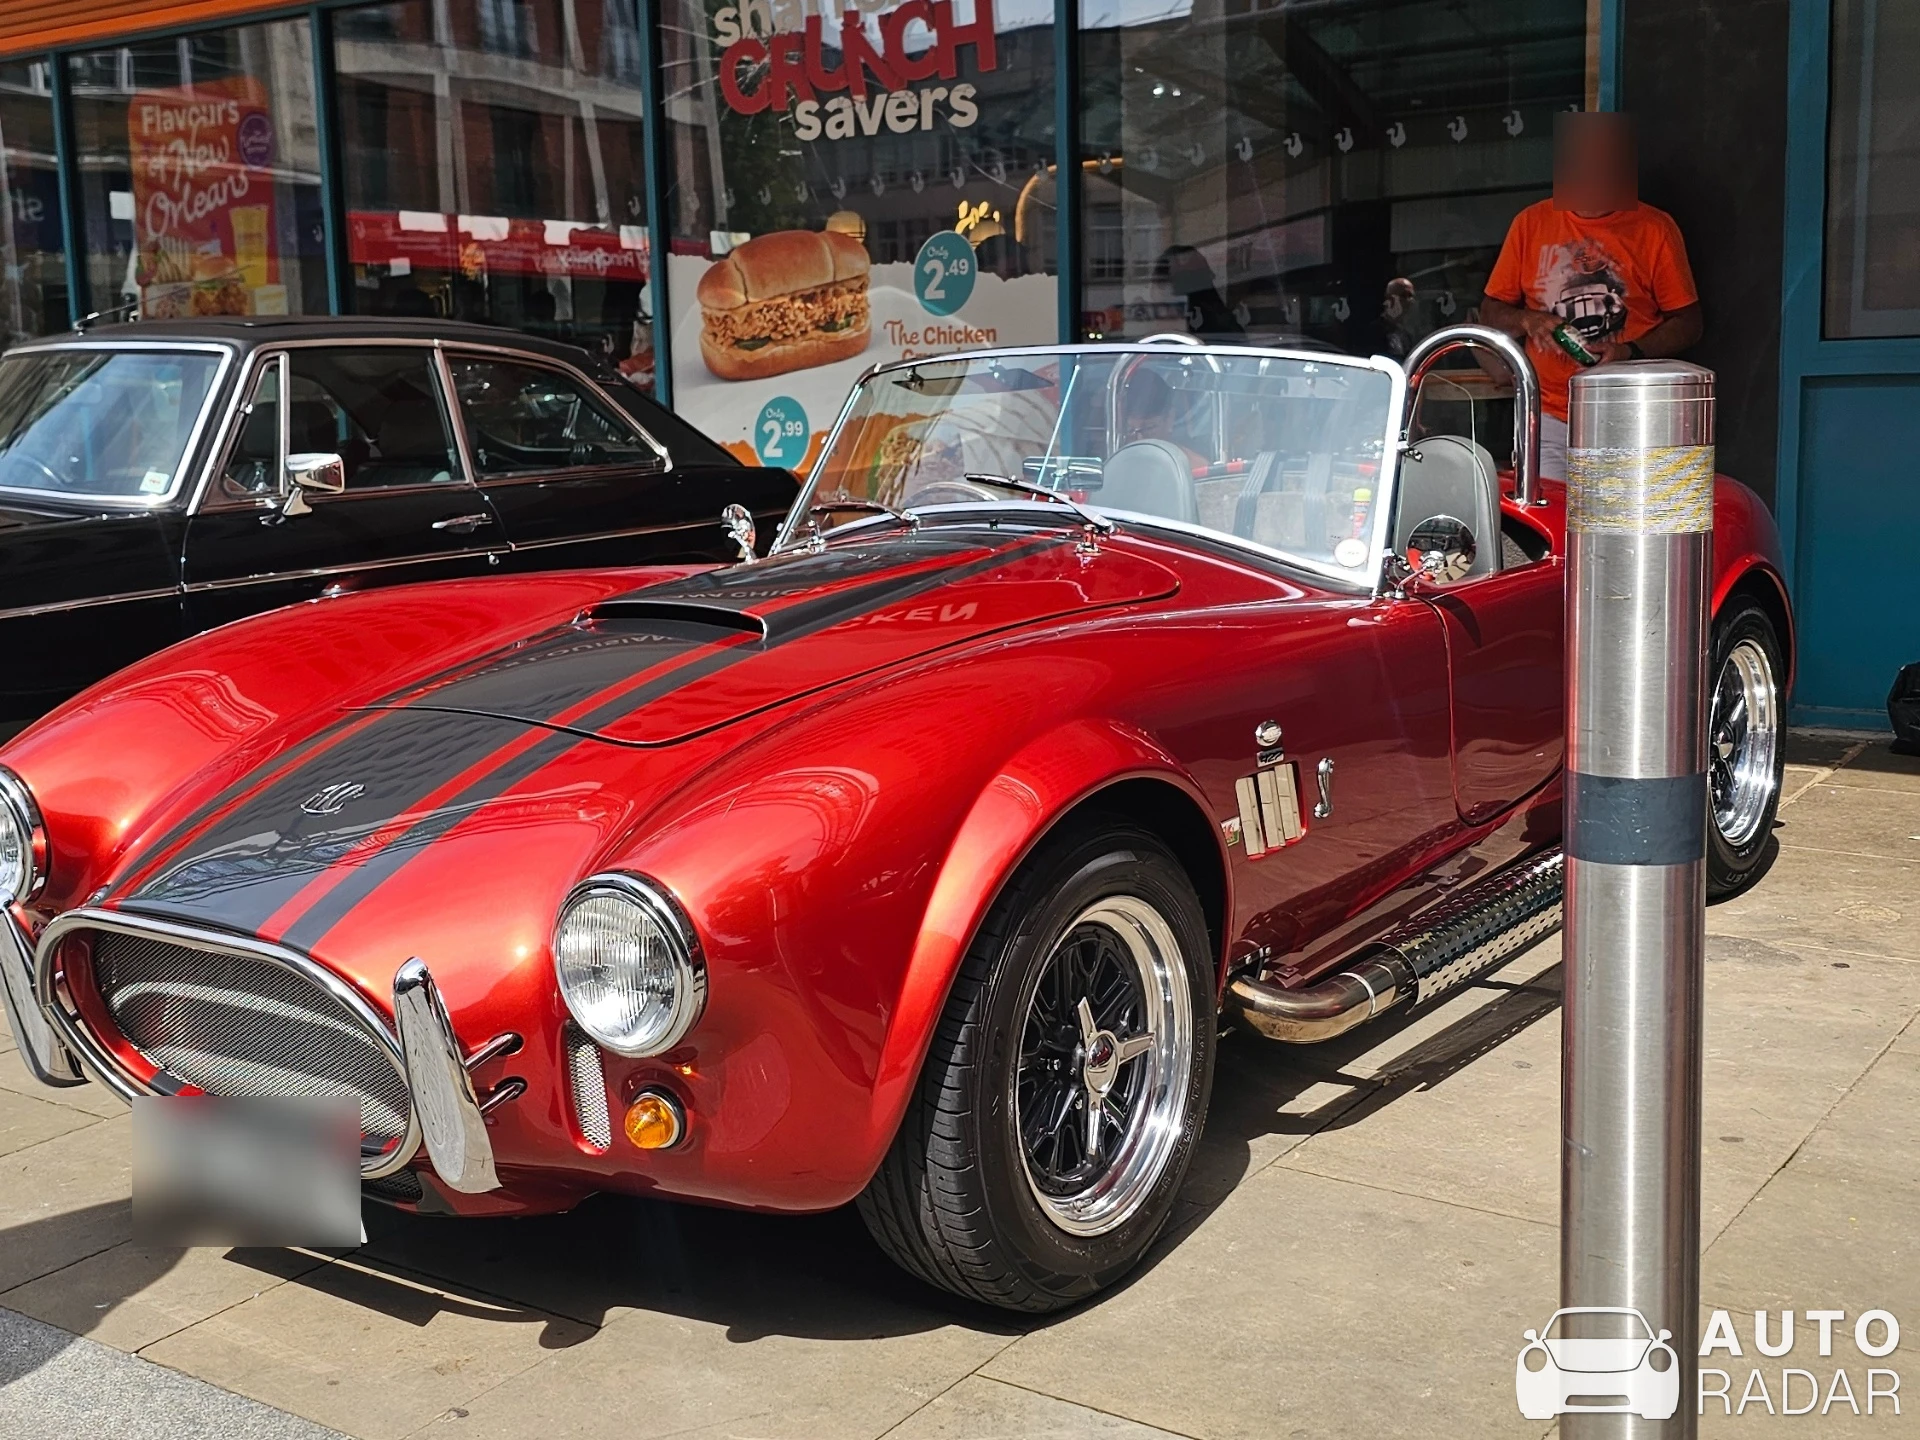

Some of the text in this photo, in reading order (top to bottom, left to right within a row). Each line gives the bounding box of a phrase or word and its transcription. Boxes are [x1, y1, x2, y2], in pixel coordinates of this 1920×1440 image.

[141, 100, 240, 137] Flavours
[794, 83, 979, 141] savers
[168, 118, 230, 192] New
[145, 165, 249, 240] Orleans
[926, 246, 949, 260] Only
[923, 258, 969, 300] 2.49
[883, 319, 998, 346] The Chicken
[765, 407, 786, 422] Only
[762, 419, 804, 458] 2.99
